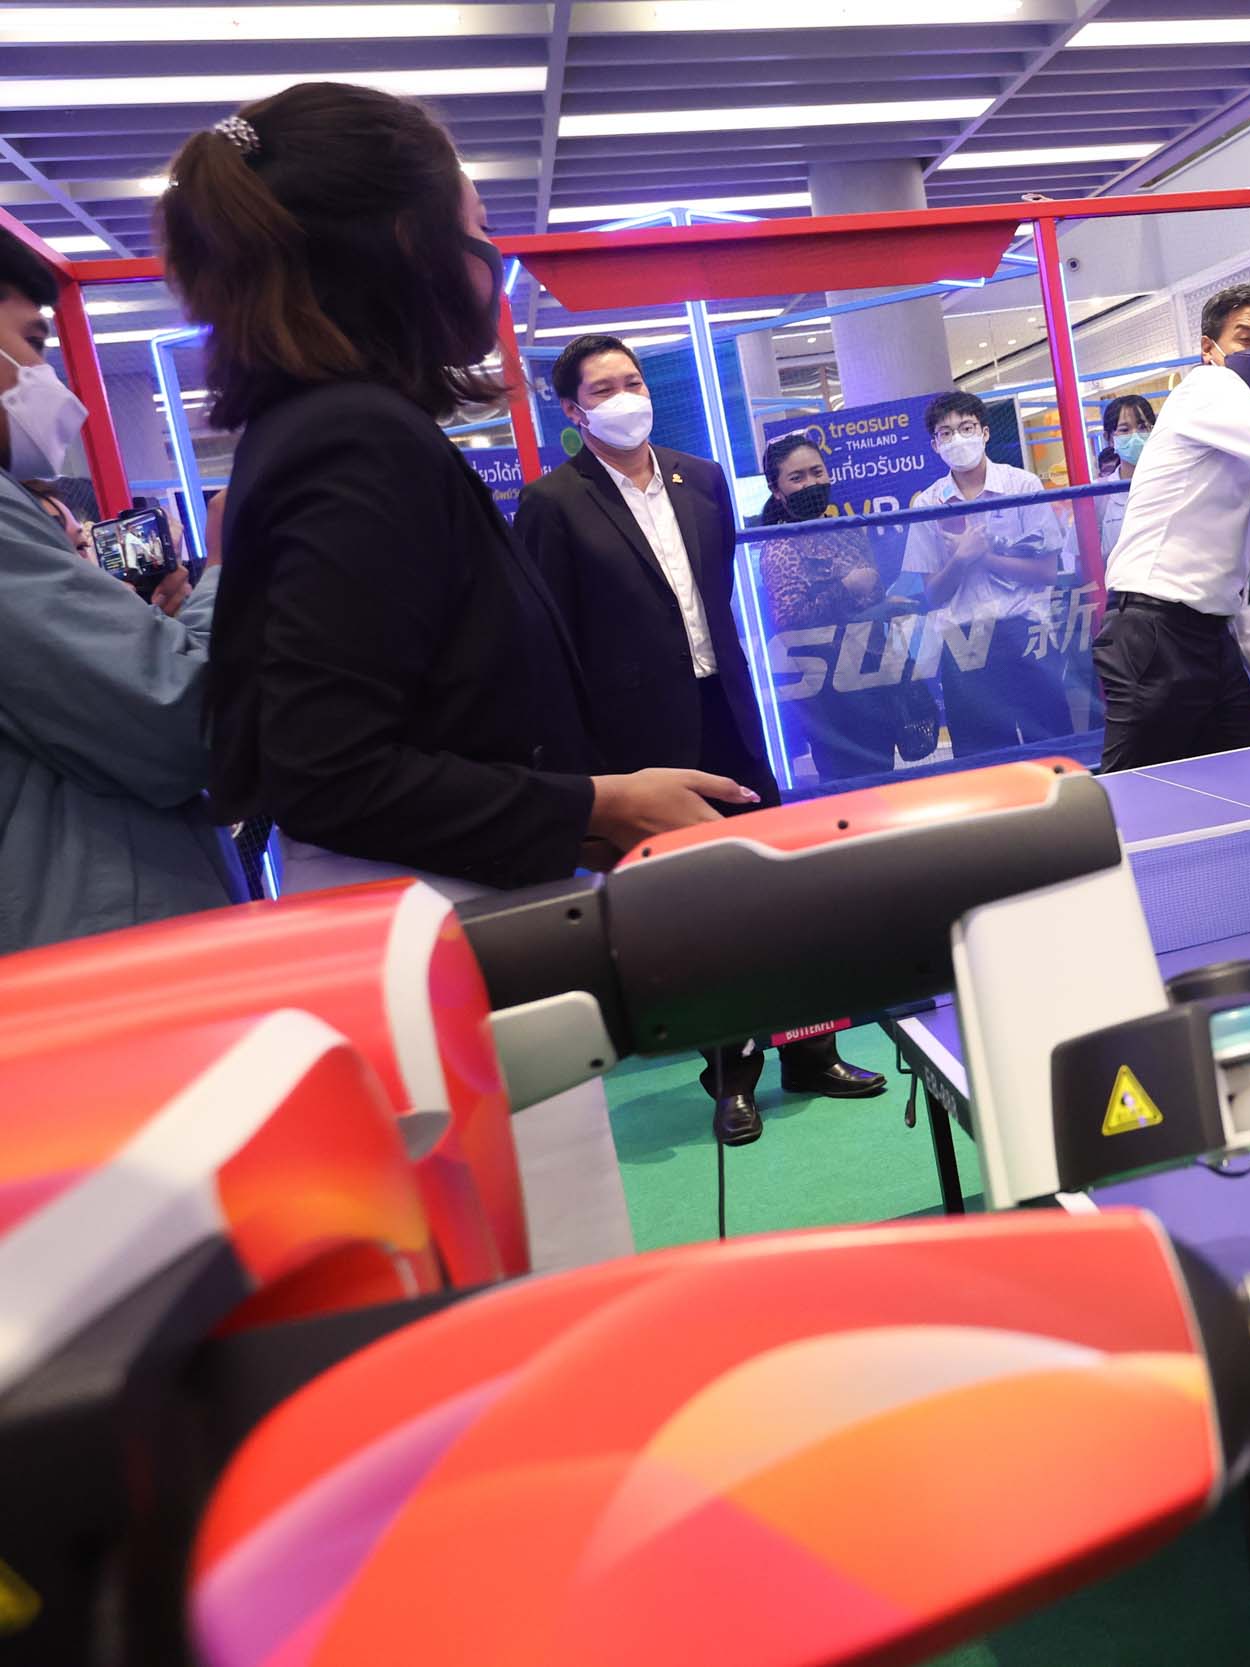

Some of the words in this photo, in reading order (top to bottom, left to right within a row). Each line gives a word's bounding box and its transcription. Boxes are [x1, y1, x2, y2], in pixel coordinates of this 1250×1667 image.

[829, 413, 909, 439] treasure
[846, 433, 898, 450] THAILAND
[758, 609, 997, 701] SUN
